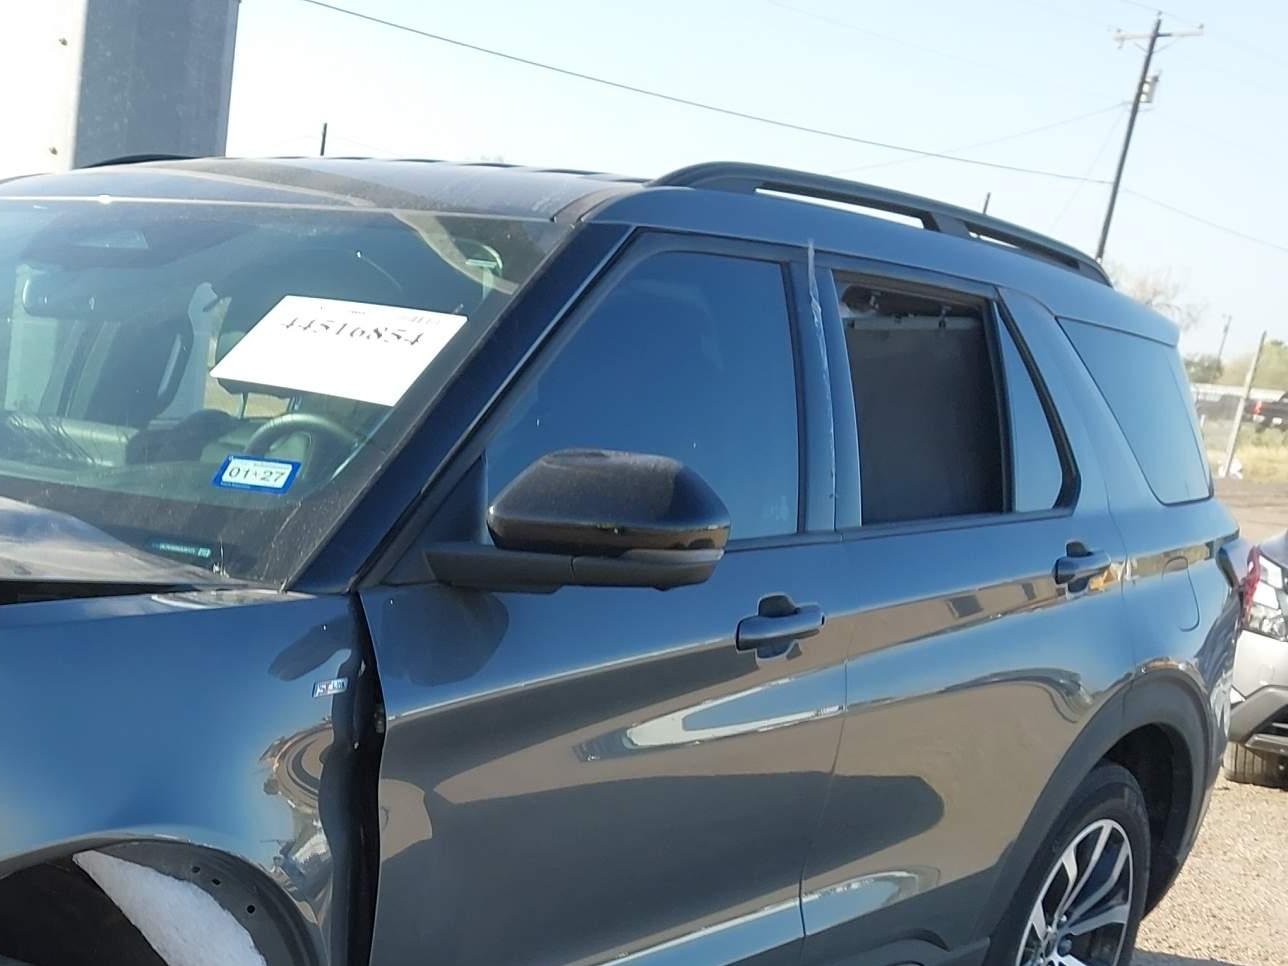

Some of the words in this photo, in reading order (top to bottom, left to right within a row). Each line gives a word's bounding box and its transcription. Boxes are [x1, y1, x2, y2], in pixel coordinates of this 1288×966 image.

[279, 316, 425, 346] 44516854
[228, 466, 251, 480] 01
[260, 470, 286, 484] 27
